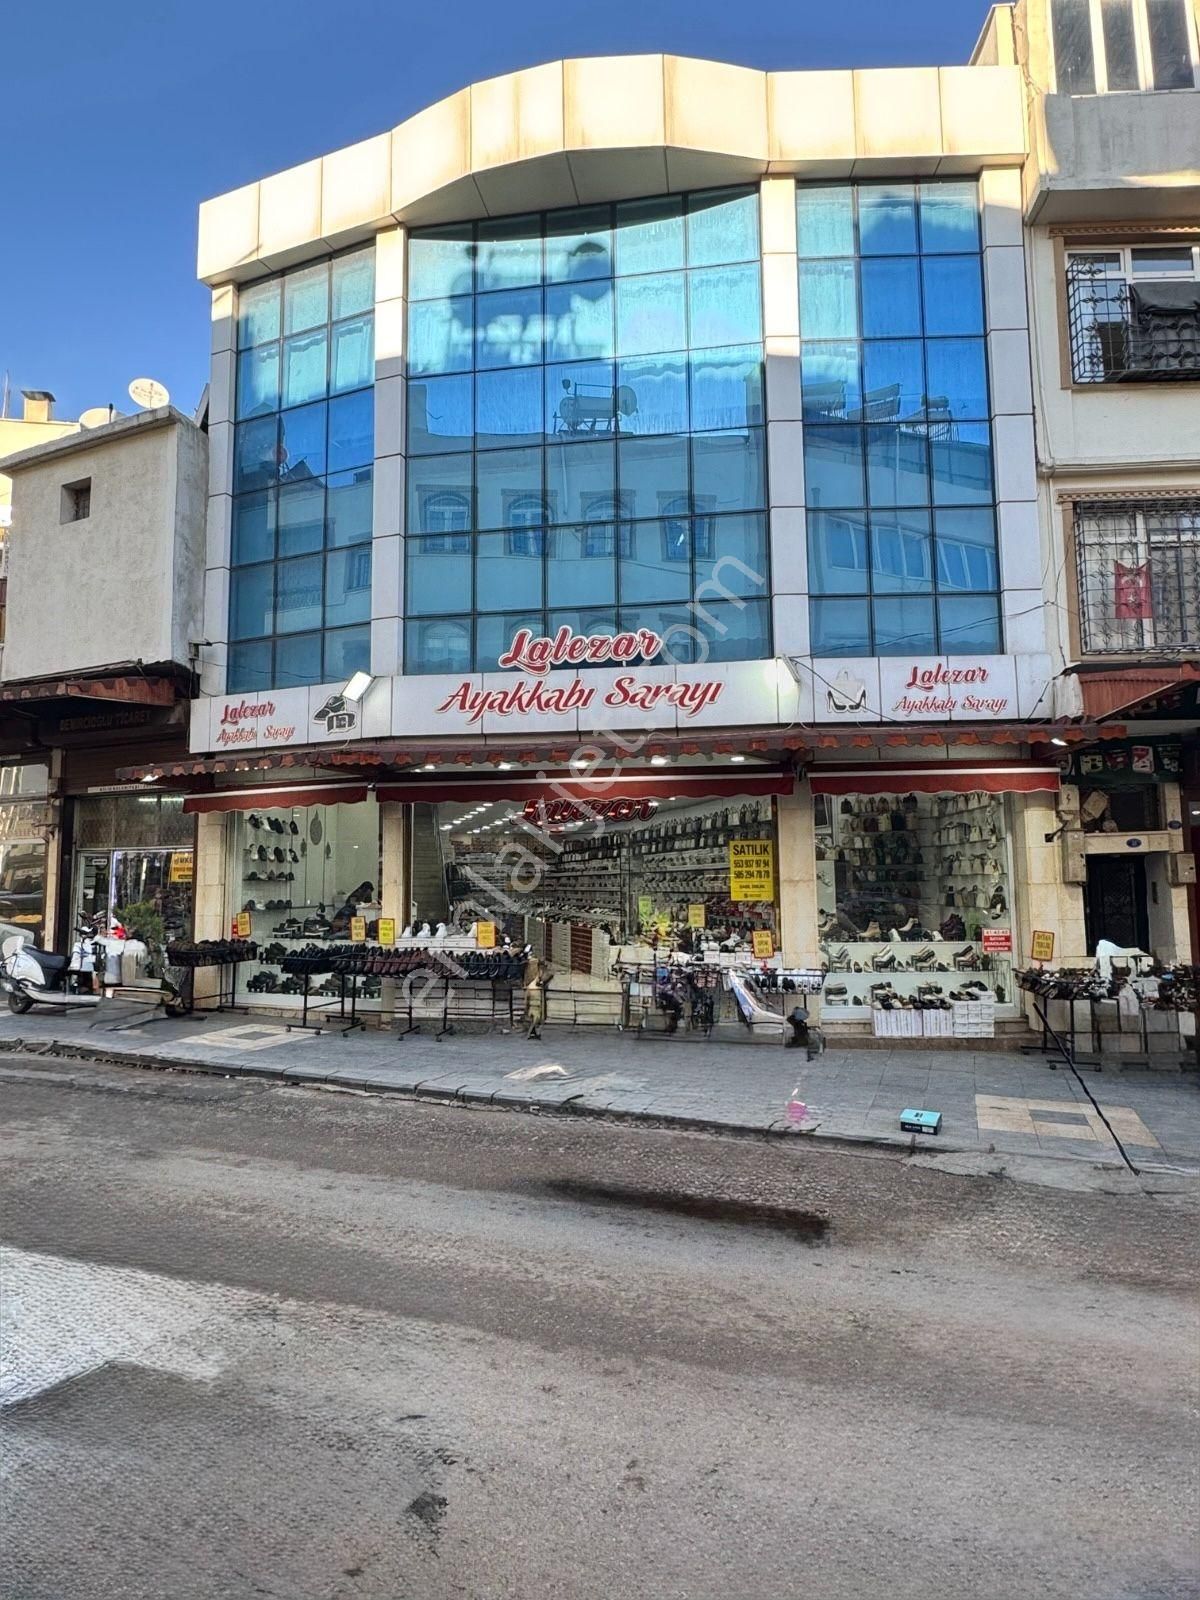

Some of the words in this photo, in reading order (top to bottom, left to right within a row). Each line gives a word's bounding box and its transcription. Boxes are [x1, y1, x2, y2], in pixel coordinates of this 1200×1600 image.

[499, 625, 664, 676] Lalezar
[904, 661, 988, 692] Lalezar
[220, 700, 276, 726] Lalezar
[436, 679, 600, 726] Ayakkabı
[603, 675, 724, 719] Sarayı
[891, 694, 958, 717] Ayakkabı
[961, 694, 1008, 716] Sarayı
[733, 844, 769, 856] SATILIK
